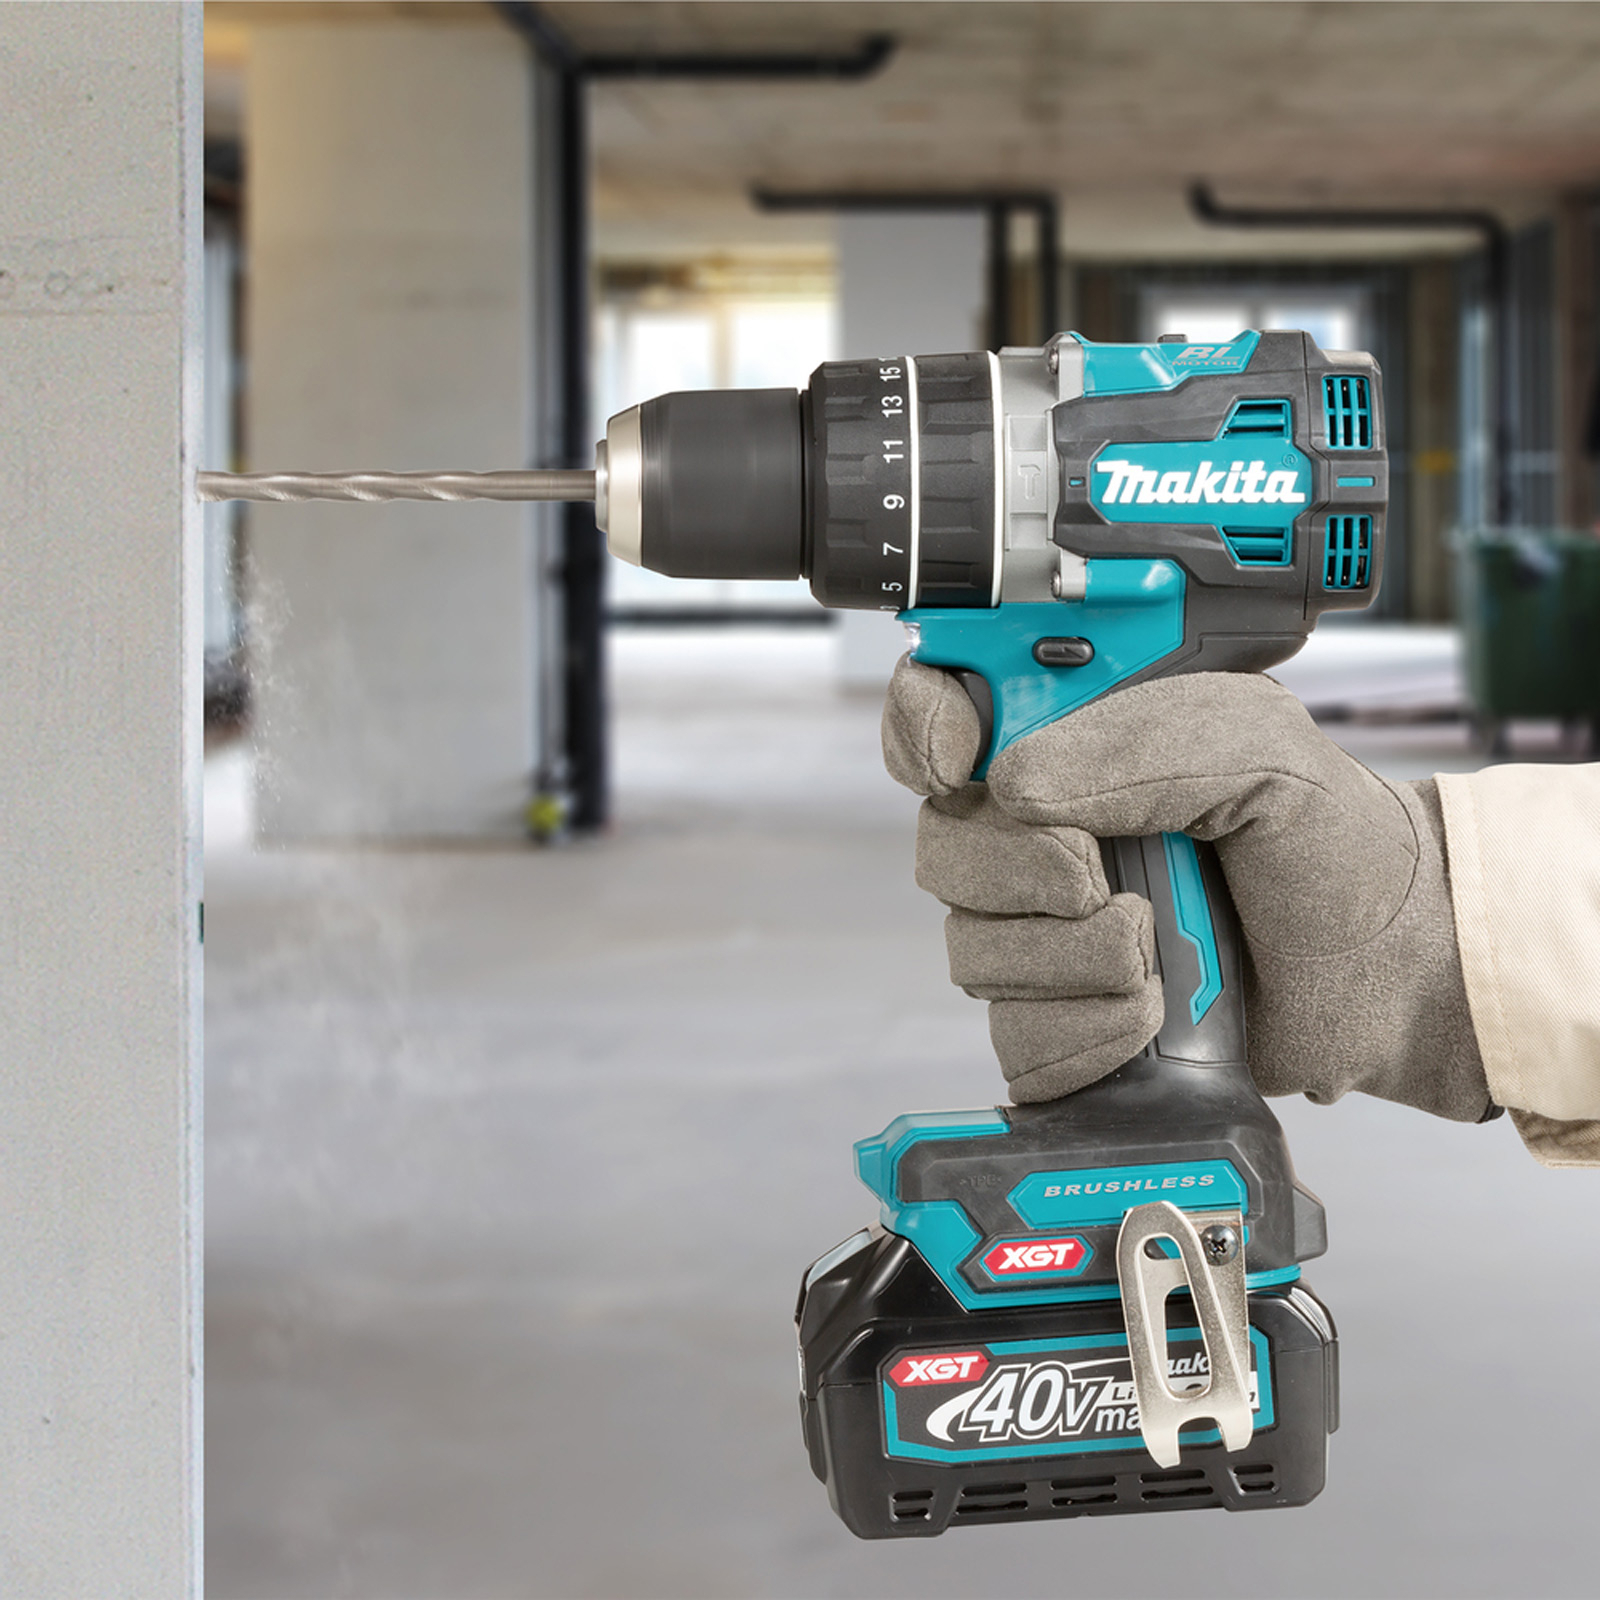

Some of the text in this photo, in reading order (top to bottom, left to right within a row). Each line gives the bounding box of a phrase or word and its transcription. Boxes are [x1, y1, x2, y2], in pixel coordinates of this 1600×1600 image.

[1176, 346, 1241, 359] BL
[879, 366, 902, 382] 15
[880, 395, 903, 418] 13
[882, 440, 904, 464] 11
[1096, 459, 1305, 504] Makita
[882, 494, 905, 510] 9
[882, 542, 904, 556] 7
[881, 582, 903, 592] 5
[1043, 1174, 1215, 1198] BRUSHLESS
[998, 1242, 1074, 1270] XGT
[902, 1355, 980, 1383] XGT
[1094, 1406, 1140, 1433] ma
